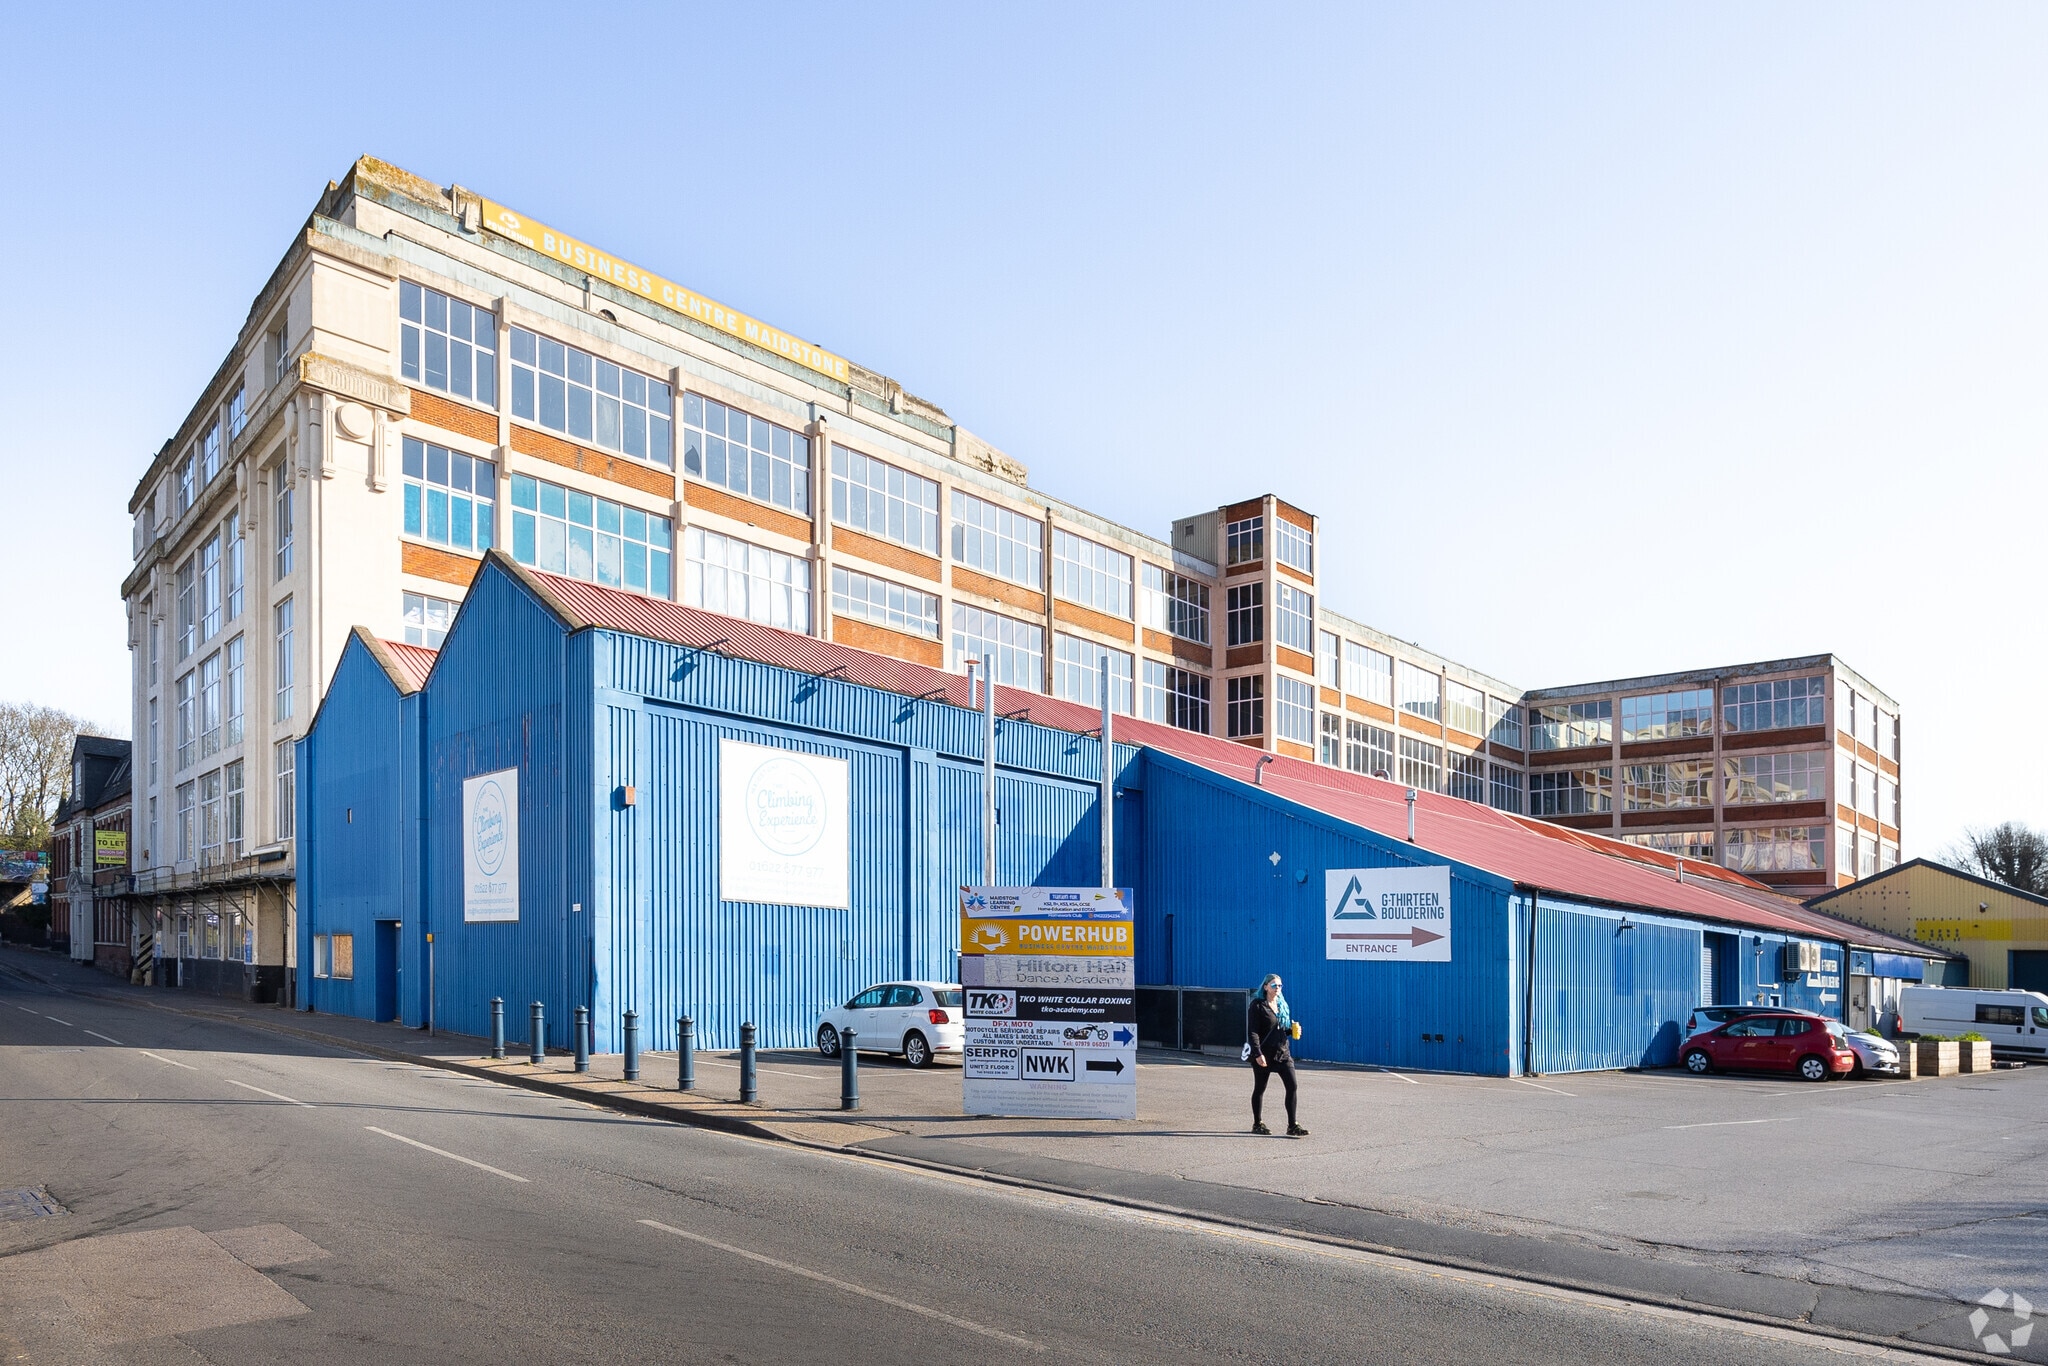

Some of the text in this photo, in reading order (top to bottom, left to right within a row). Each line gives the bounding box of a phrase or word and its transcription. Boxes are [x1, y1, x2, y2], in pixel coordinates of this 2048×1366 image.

[486, 219, 534, 248] POWERHUB
[544, 232, 845, 378] BUSINESS CENTRE MAIDSTONE
[757, 789, 815, 815] Climbing
[477, 810, 503, 834] Climbing
[759, 809, 818, 833] Experience
[478, 832, 503, 856] Experience
[1381, 906, 1445, 920] BOULDERING
[1018, 925, 1128, 943] POWERHUB
[1346, 944, 1398, 954] ENTRANCE
[1016, 960, 1077, 973] Hilton
[1016, 974, 1127, 987] Dance Academy
[1019, 995, 1132, 1005] TKO WHITE COLLAR BOXING
[1041, 1006, 1105, 1015] tko-academy.com
[966, 1048, 1018, 1058] SERPRO
[1026, 1055, 1070, 1073] NWK
